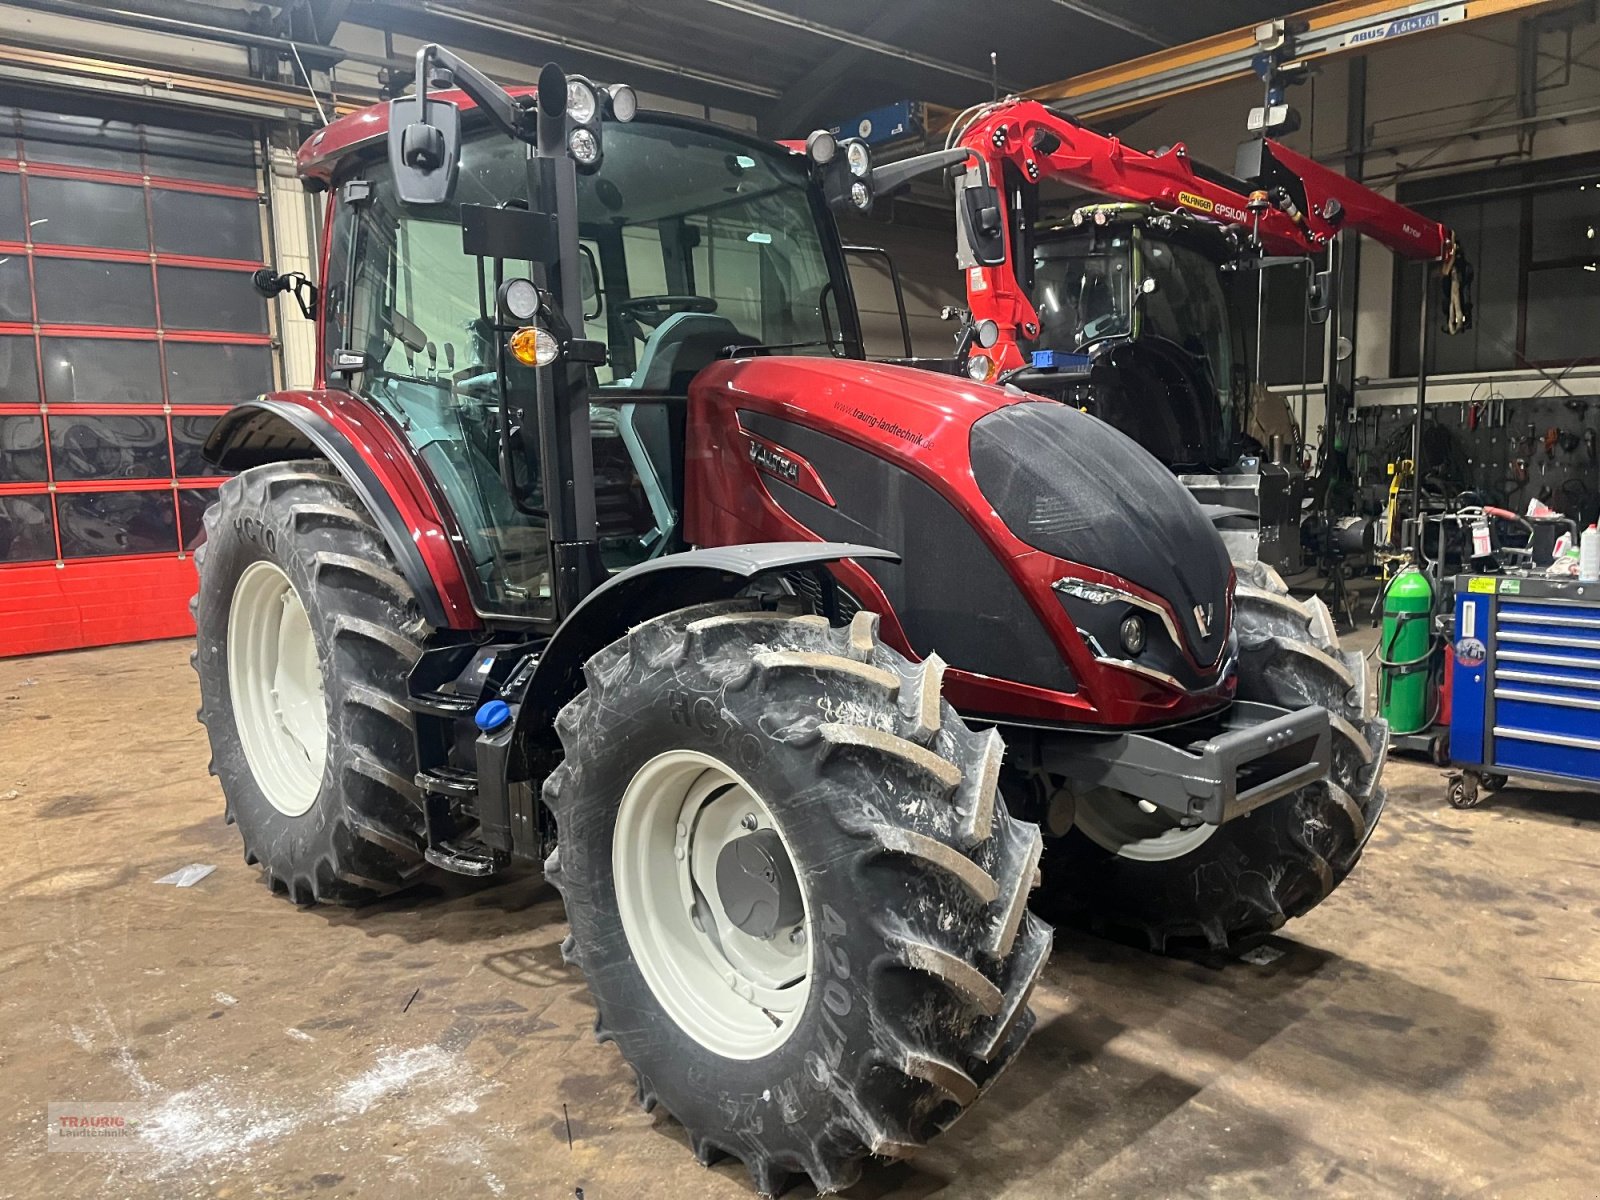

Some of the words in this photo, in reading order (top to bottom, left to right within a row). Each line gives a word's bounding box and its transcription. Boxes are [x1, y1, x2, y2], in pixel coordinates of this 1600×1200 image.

[1350, 28, 1384, 43] ABUS
[1393, 15, 1435, 34] 1,6t+1,6t
[1180, 193, 1212, 210] PALFINGER
[1215, 203, 1247, 223] EPSILON
[834, 401, 935, 451] www.traurig-landtechnik.de
[750, 440, 798, 480] VALTRA
